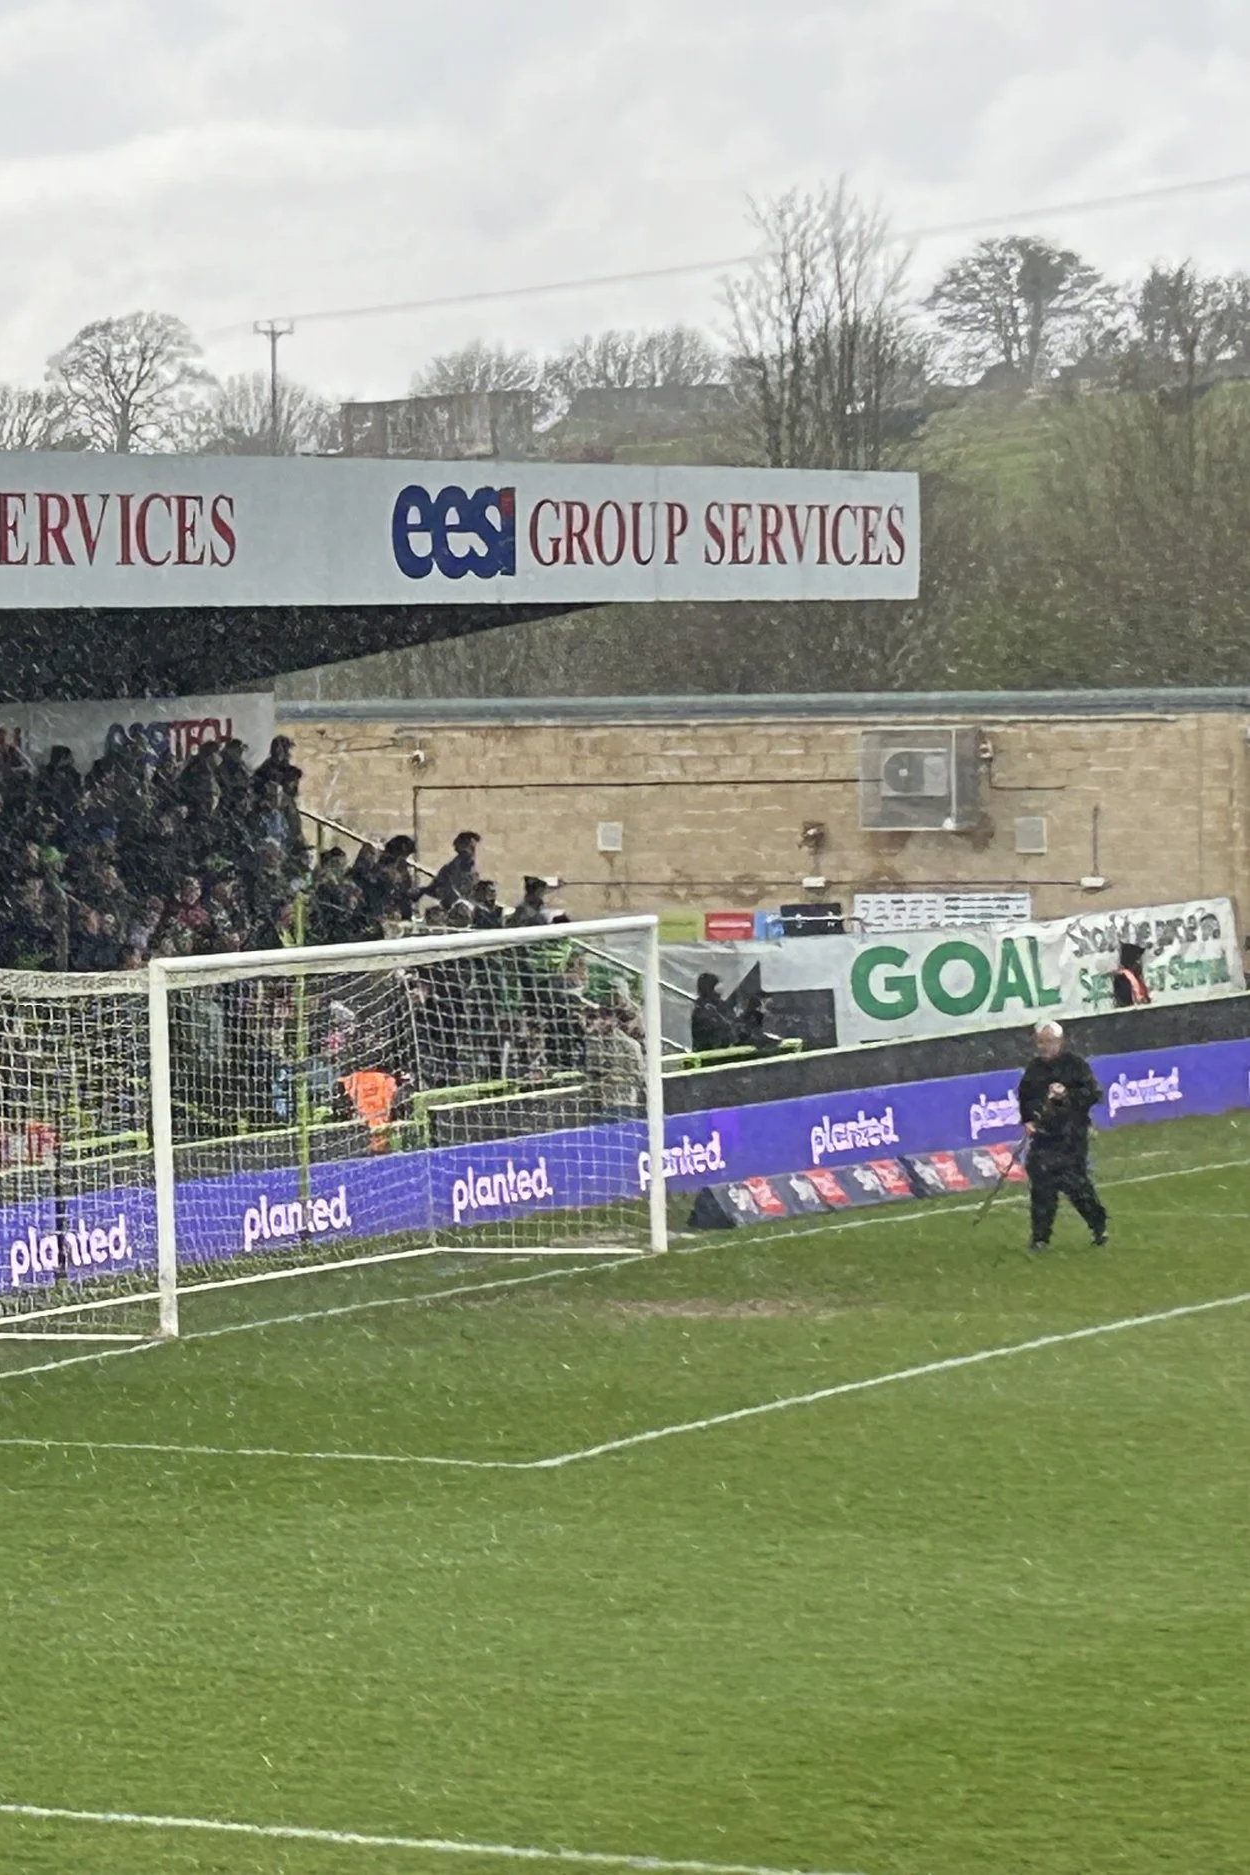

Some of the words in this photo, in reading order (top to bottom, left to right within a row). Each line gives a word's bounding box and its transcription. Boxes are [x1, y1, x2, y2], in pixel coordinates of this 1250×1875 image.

[529, 498, 687, 567] GROUP
[703, 503, 905, 567] SERVICES
[851, 936, 1061, 1020] GOAL
